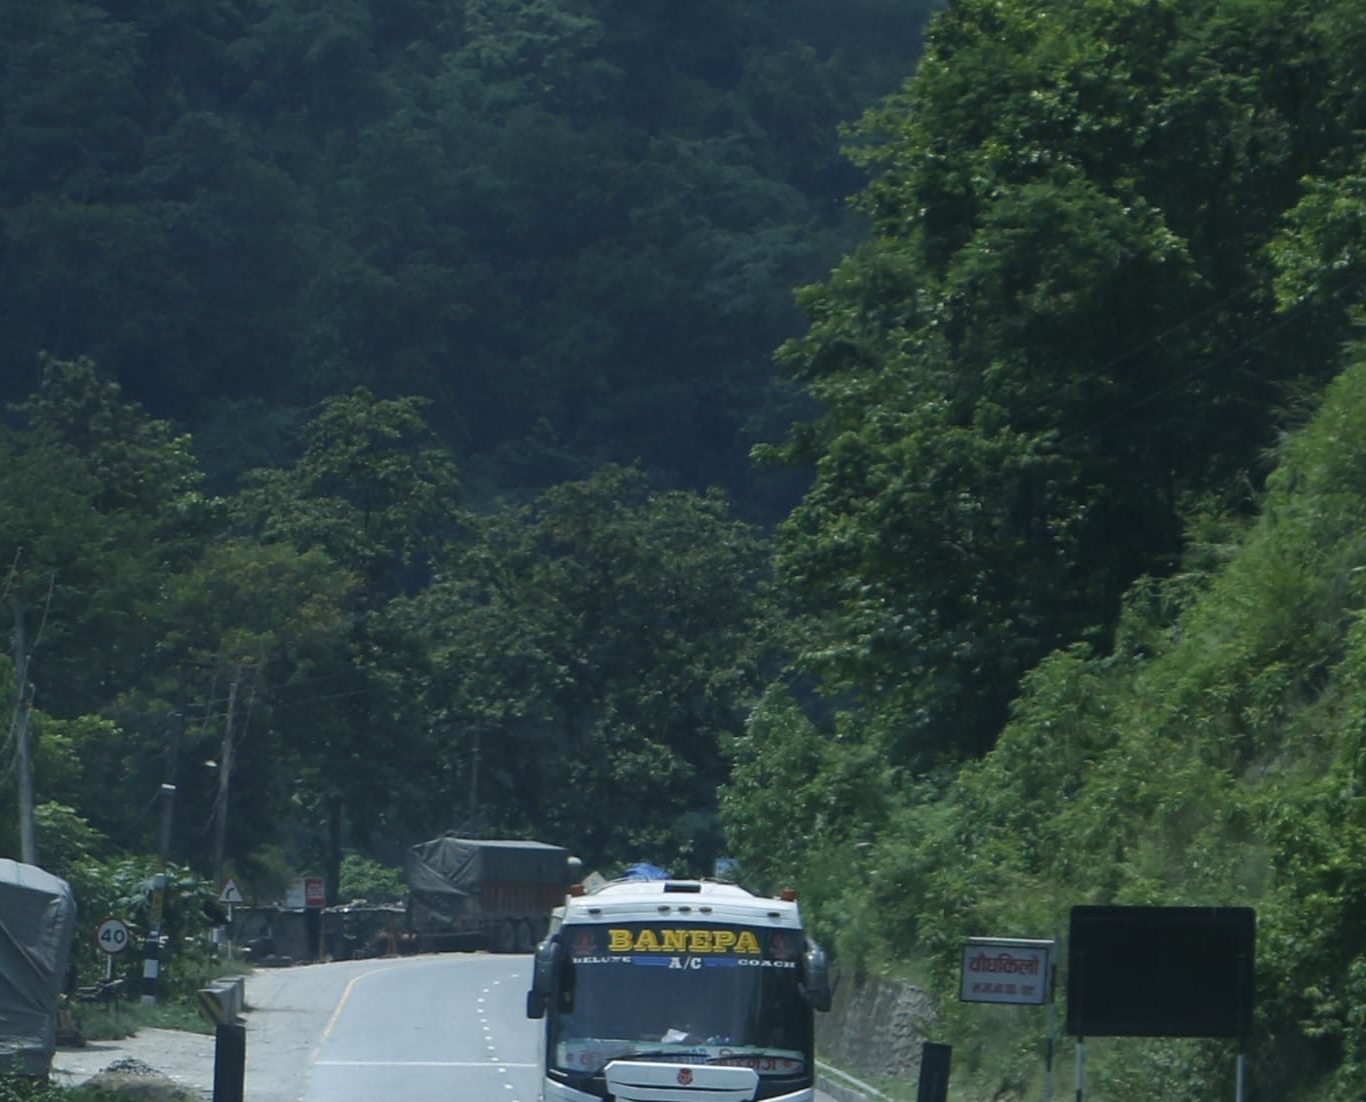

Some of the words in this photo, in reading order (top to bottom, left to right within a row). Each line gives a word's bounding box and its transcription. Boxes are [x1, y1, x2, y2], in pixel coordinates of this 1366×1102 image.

[101, 928, 125, 944] 40
[608, 929, 762, 954] BANEPA
[668, 957, 702, 970] A/C
[737, 958, 796, 968] COACH
